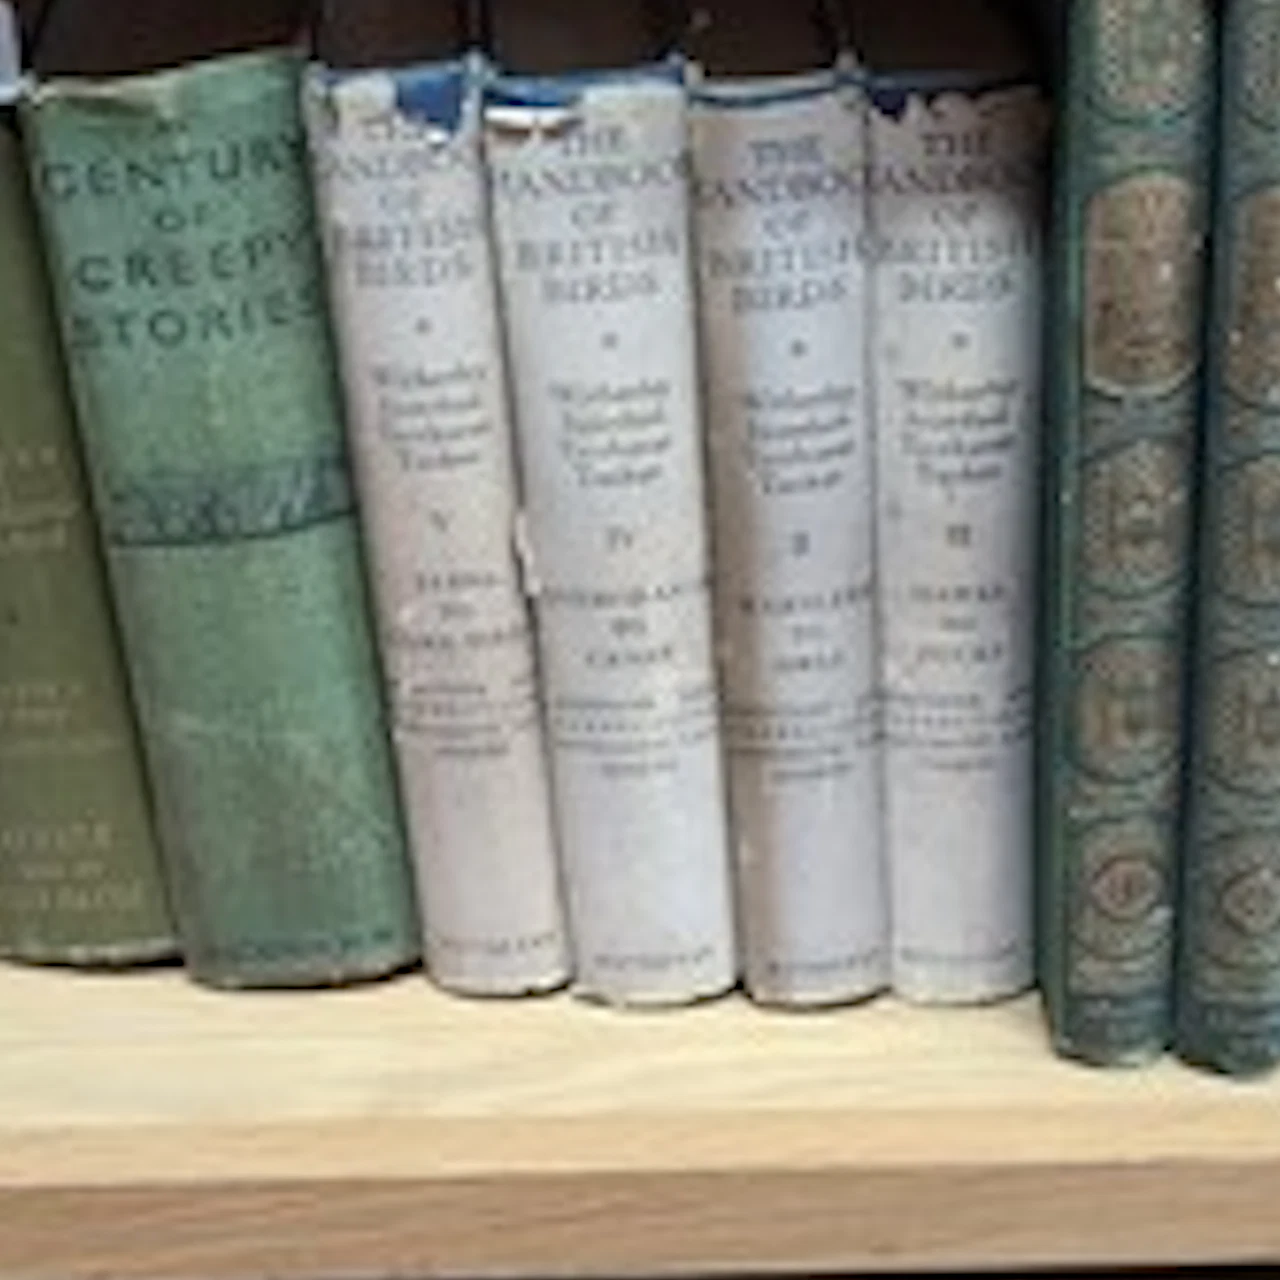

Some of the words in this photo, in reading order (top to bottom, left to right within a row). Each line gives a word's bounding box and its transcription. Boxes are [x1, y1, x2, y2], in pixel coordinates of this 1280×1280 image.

[40, 128, 308, 200] CENTURY
[154, 198, 214, 234] OF
[77, 230, 312, 295] CREEPY
[70, 286, 322, 356] STORIES
